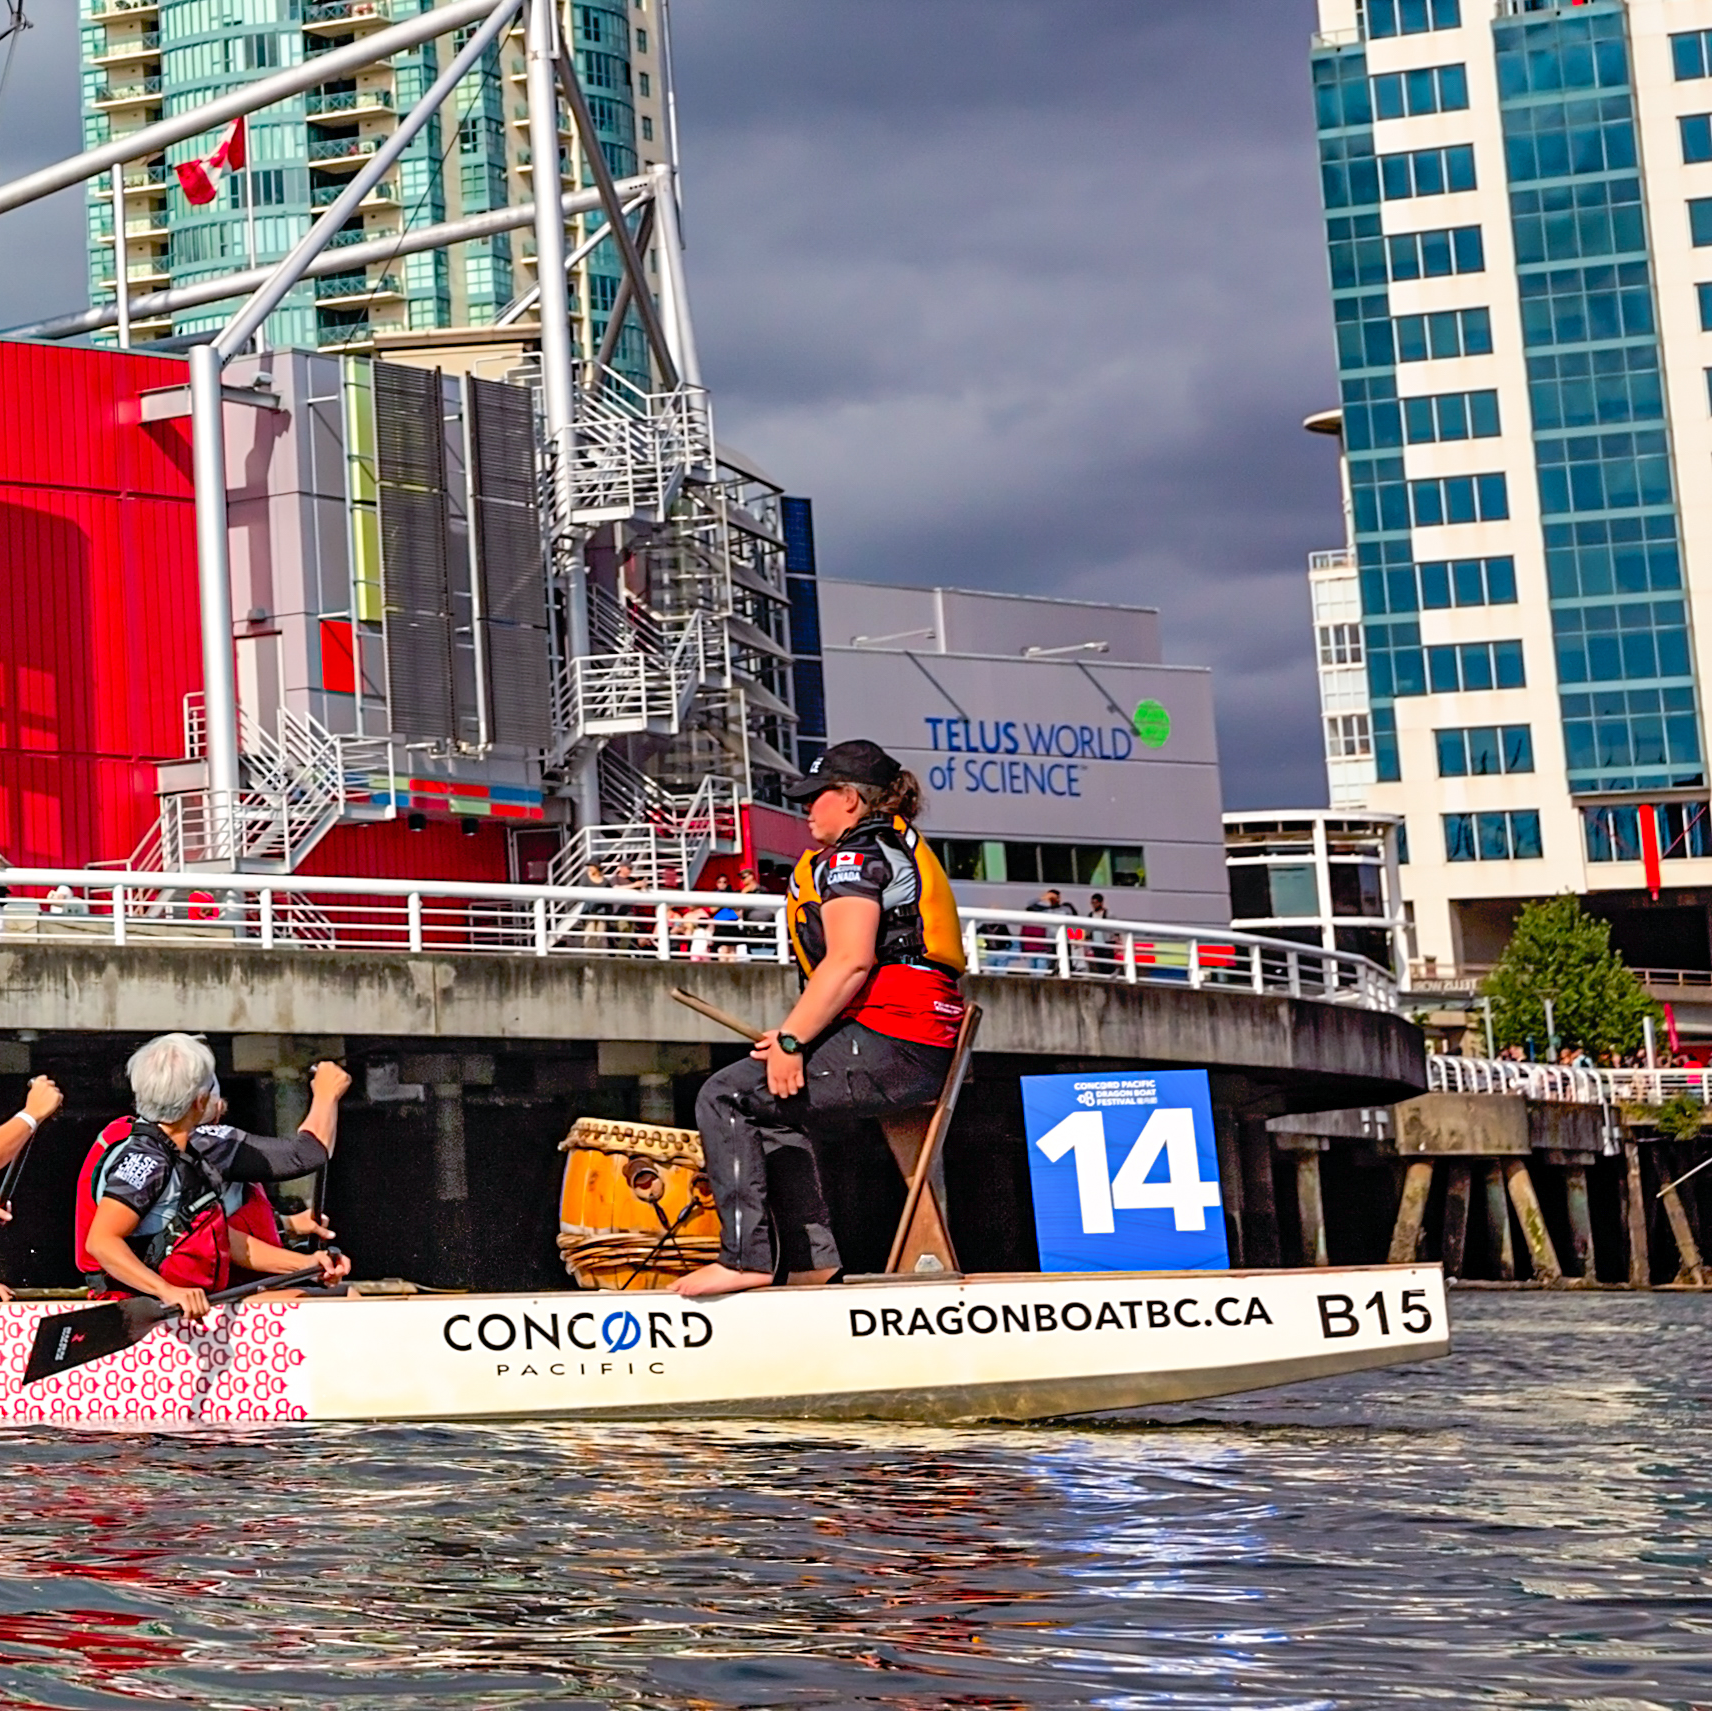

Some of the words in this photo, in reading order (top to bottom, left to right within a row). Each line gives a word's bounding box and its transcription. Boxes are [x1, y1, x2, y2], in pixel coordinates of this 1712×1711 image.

[924, 717, 1020, 754] TELUS
[1023, 723, 1133, 760] WORLD
[929, 756, 956, 790] of
[964, 759, 1082, 797] SCIENCE
[827, 871, 861, 885] CANADA
[1073, 1081, 1120, 1091] CONCORD
[1121, 1079, 1156, 1089] PACIFIC
[1095, 1089, 1133, 1098] DRAGON
[1133, 1088, 1157, 1097] BOAT
[1096, 1098, 1136, 1106] FESTIVAL
[1036, 1107, 1221, 1234] 14
[849, 1296, 1273, 1338] DRAGONBOATBC.CA
[1317, 1289, 1432, 1338] B15
[496, 1362, 665, 1376] PACIFIC
